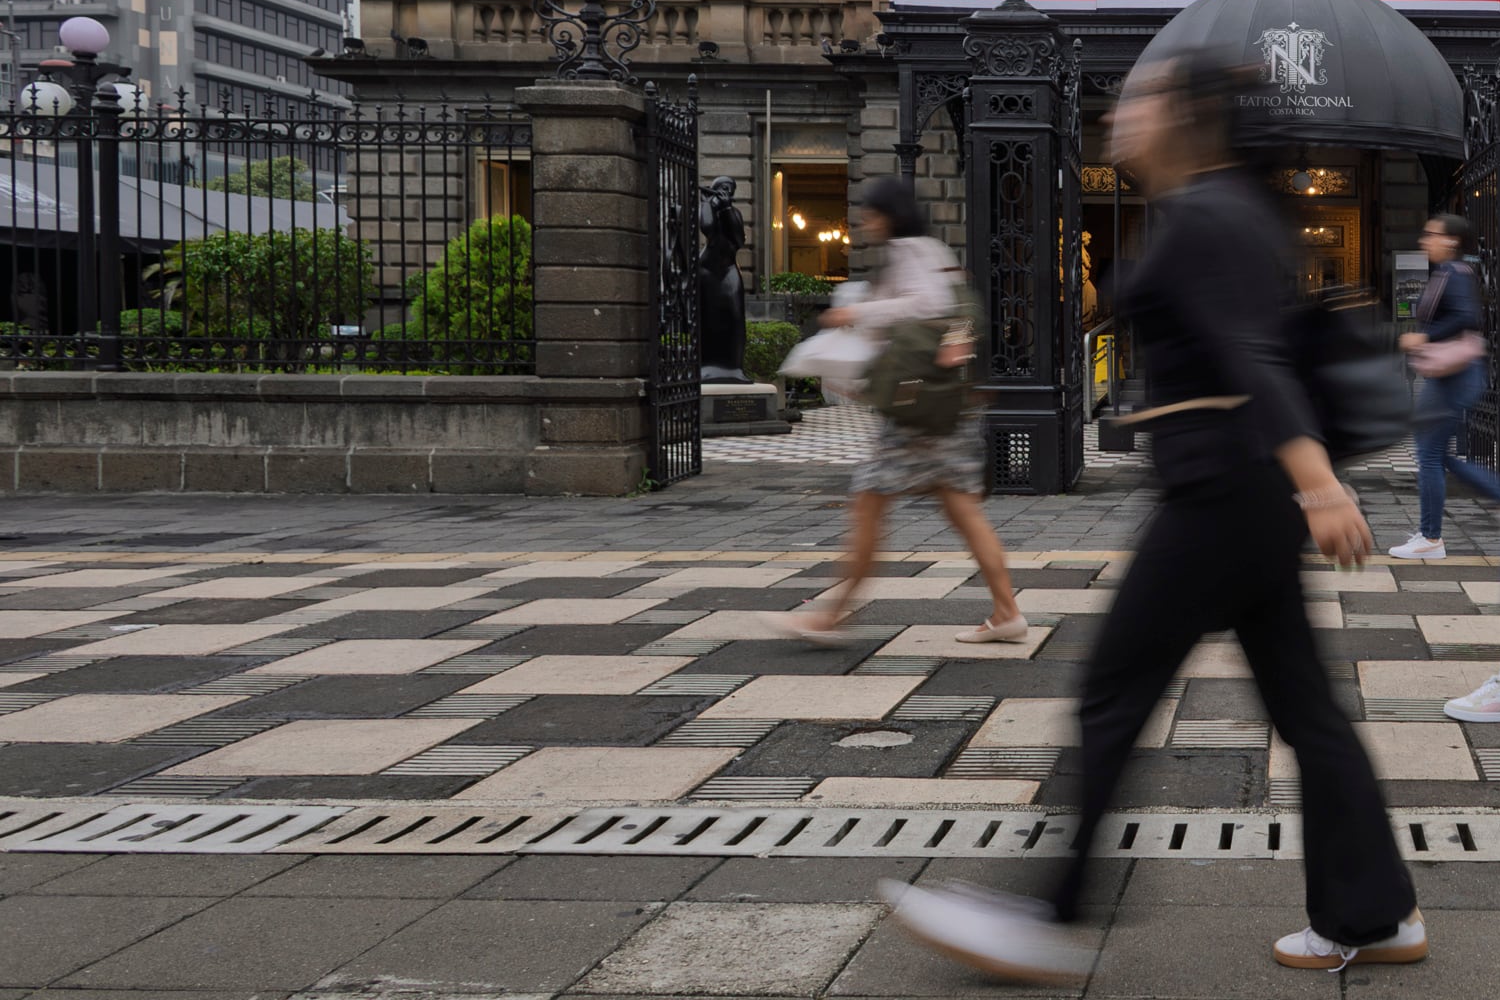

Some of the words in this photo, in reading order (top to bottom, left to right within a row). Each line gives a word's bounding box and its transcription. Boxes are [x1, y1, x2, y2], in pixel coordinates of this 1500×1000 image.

[1286, 96, 1354, 108] NACIONAL
[1269, 108, 1294, 116] COSTA
[1295, 108, 1315, 116] RICA
